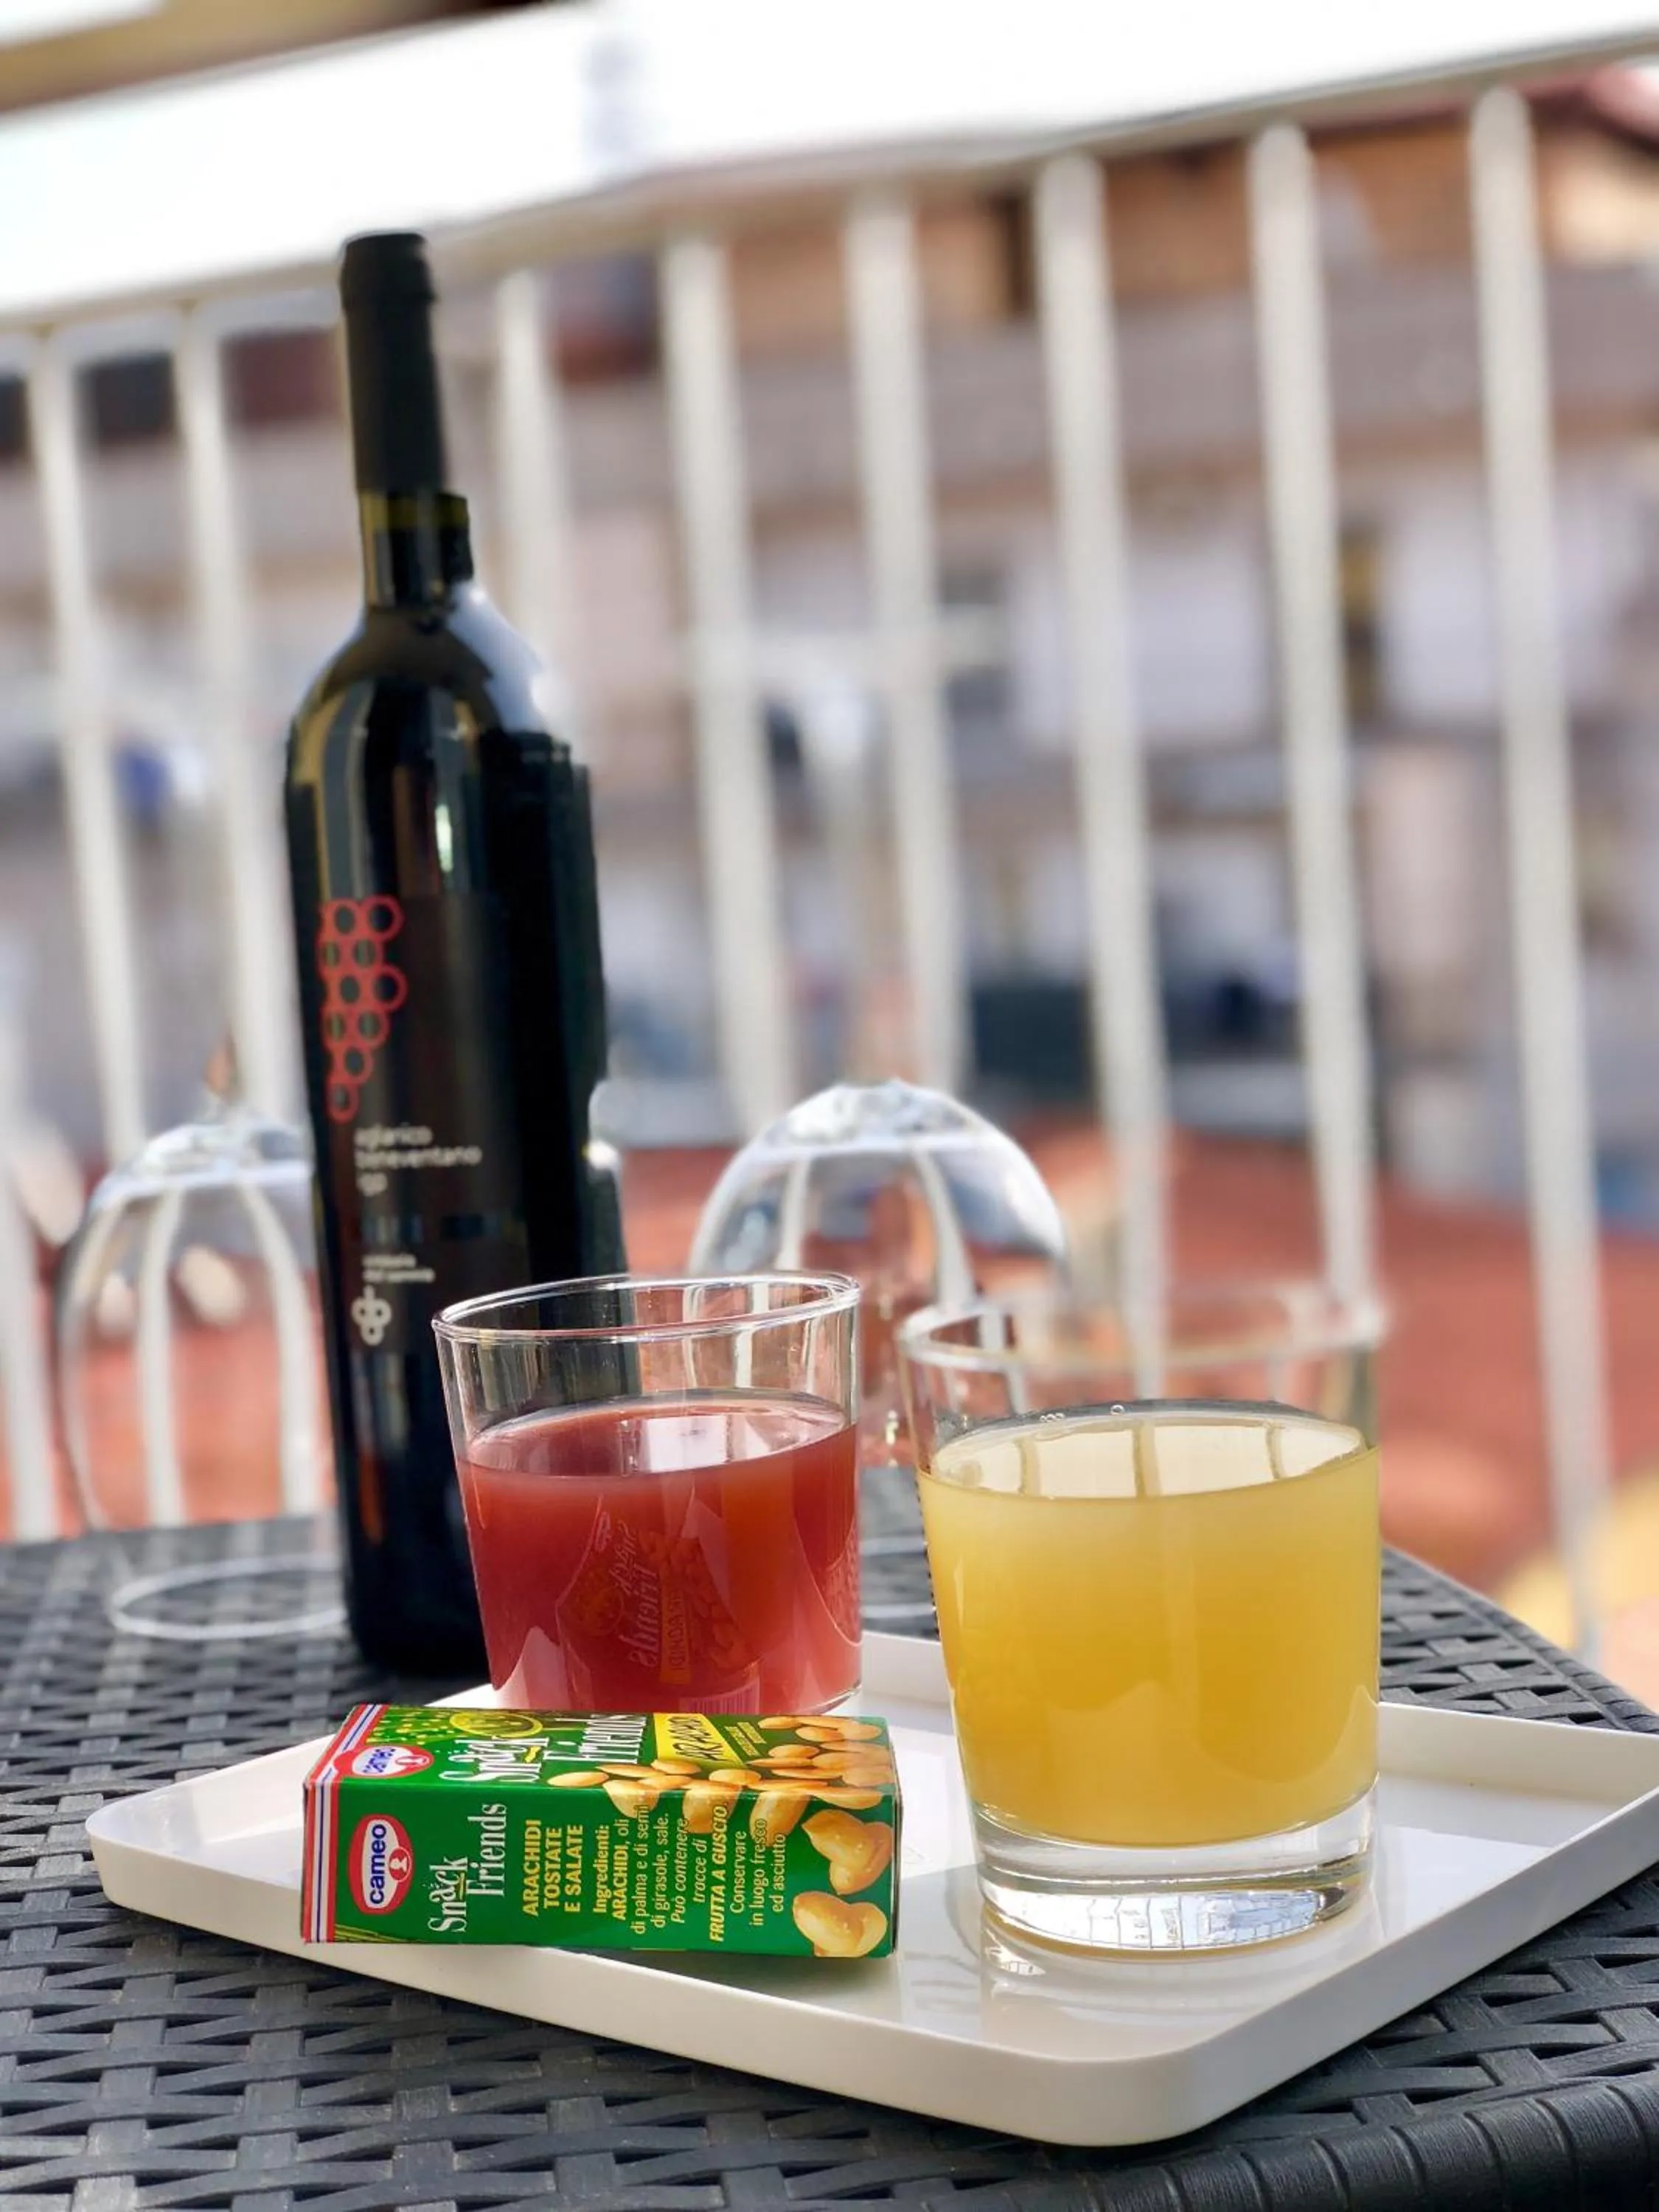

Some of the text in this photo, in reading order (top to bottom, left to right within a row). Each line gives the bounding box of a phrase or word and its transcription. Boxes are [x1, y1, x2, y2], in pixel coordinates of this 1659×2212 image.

[439, 1736, 549, 1783] Snack
[543, 1714, 647, 1764] Friends
[369, 1823, 387, 1905] cameo
[467, 1803, 507, 1896] Friends
[522, 1819, 542, 1916] ARACHIDI
[543, 1827, 563, 1909] TOSTATE
[565, 1824, 583, 1913] E SALATE
[593, 1825, 611, 1913] Ingredienti:
[612, 1818, 631, 1921] ARACHIDI, oli
[632, 1805, 650, 1934] di palma e di semi
[652, 1813, 670, 1928] di girasole, sale.
[671, 1818, 689, 1924] Può contenere
[692, 1839, 708, 1903] tracce di
[710, 1802, 728, 1942] FRUTTA A GUSCIO.
[730, 1831, 746, 1913] Conservare
[749, 1818, 768, 1926] in luogo fresco
[769, 1834, 785, 1913] ed asciutto
[428, 1857, 467, 1933] Snack
